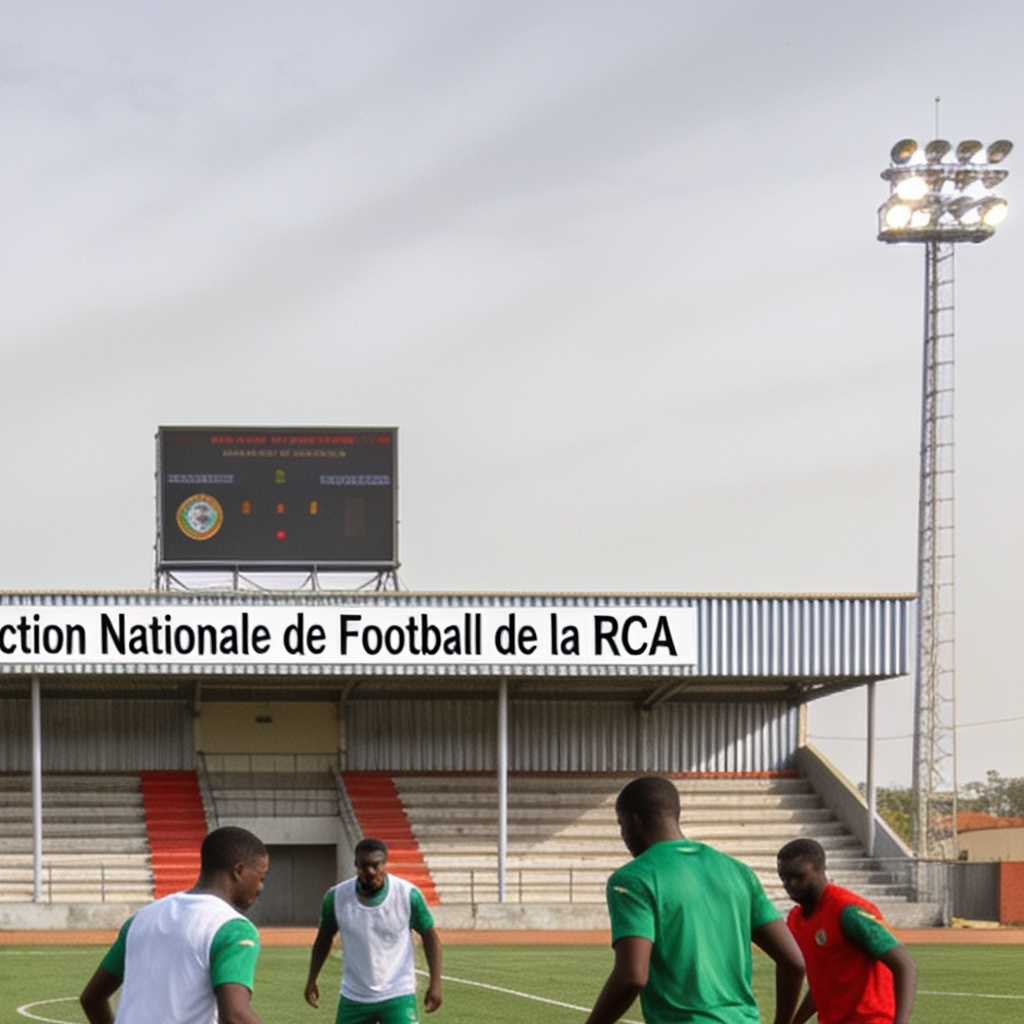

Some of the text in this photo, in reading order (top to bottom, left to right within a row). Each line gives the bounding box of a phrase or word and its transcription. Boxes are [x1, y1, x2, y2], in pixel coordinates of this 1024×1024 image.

[100, 612, 270, 654] Nationale
[283, 612, 325, 655] de
[340, 613, 481, 655] Football
[494, 612, 537, 655] de
[550, 612, 579, 655] la
[594, 614, 678, 655] RCA
